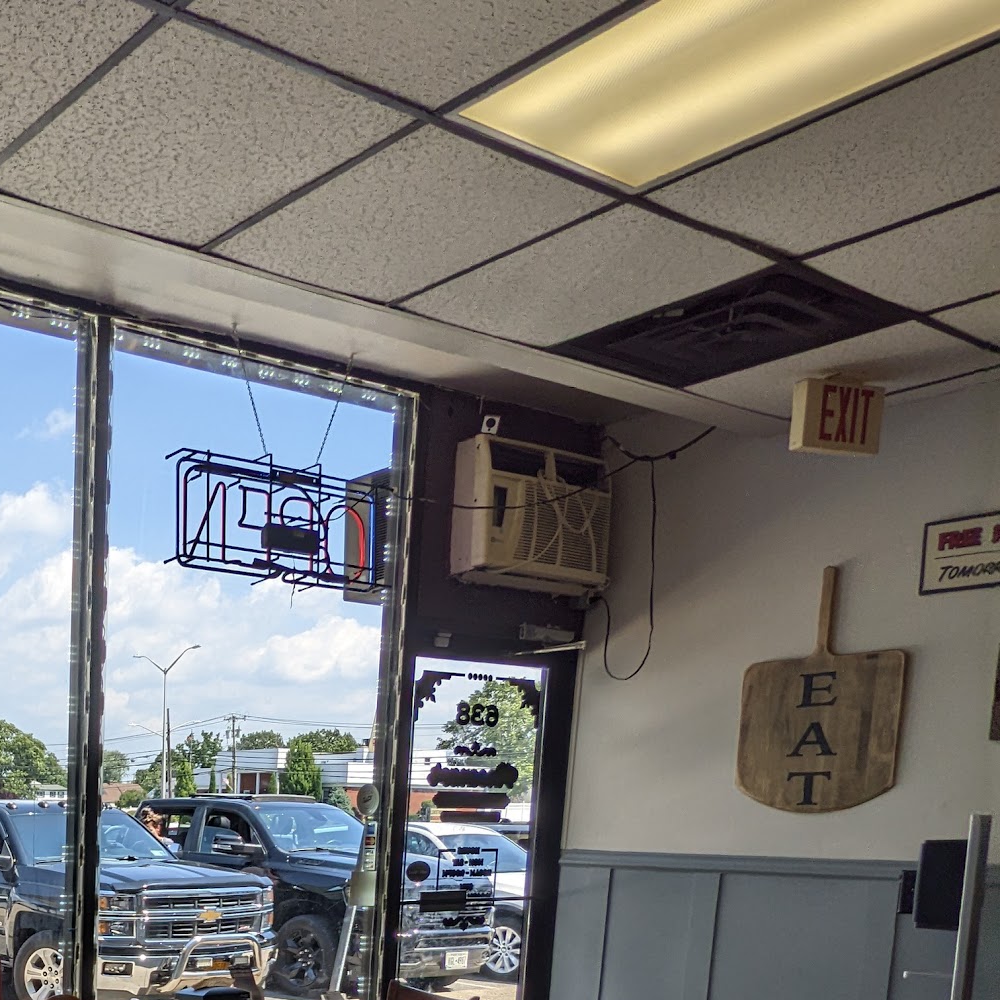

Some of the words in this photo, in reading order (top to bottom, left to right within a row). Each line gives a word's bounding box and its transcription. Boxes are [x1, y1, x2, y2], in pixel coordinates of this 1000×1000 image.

[818, 384, 876, 445] EXIT
[937, 526, 984, 551] FREE
[785, 670, 839, 807] EAT
